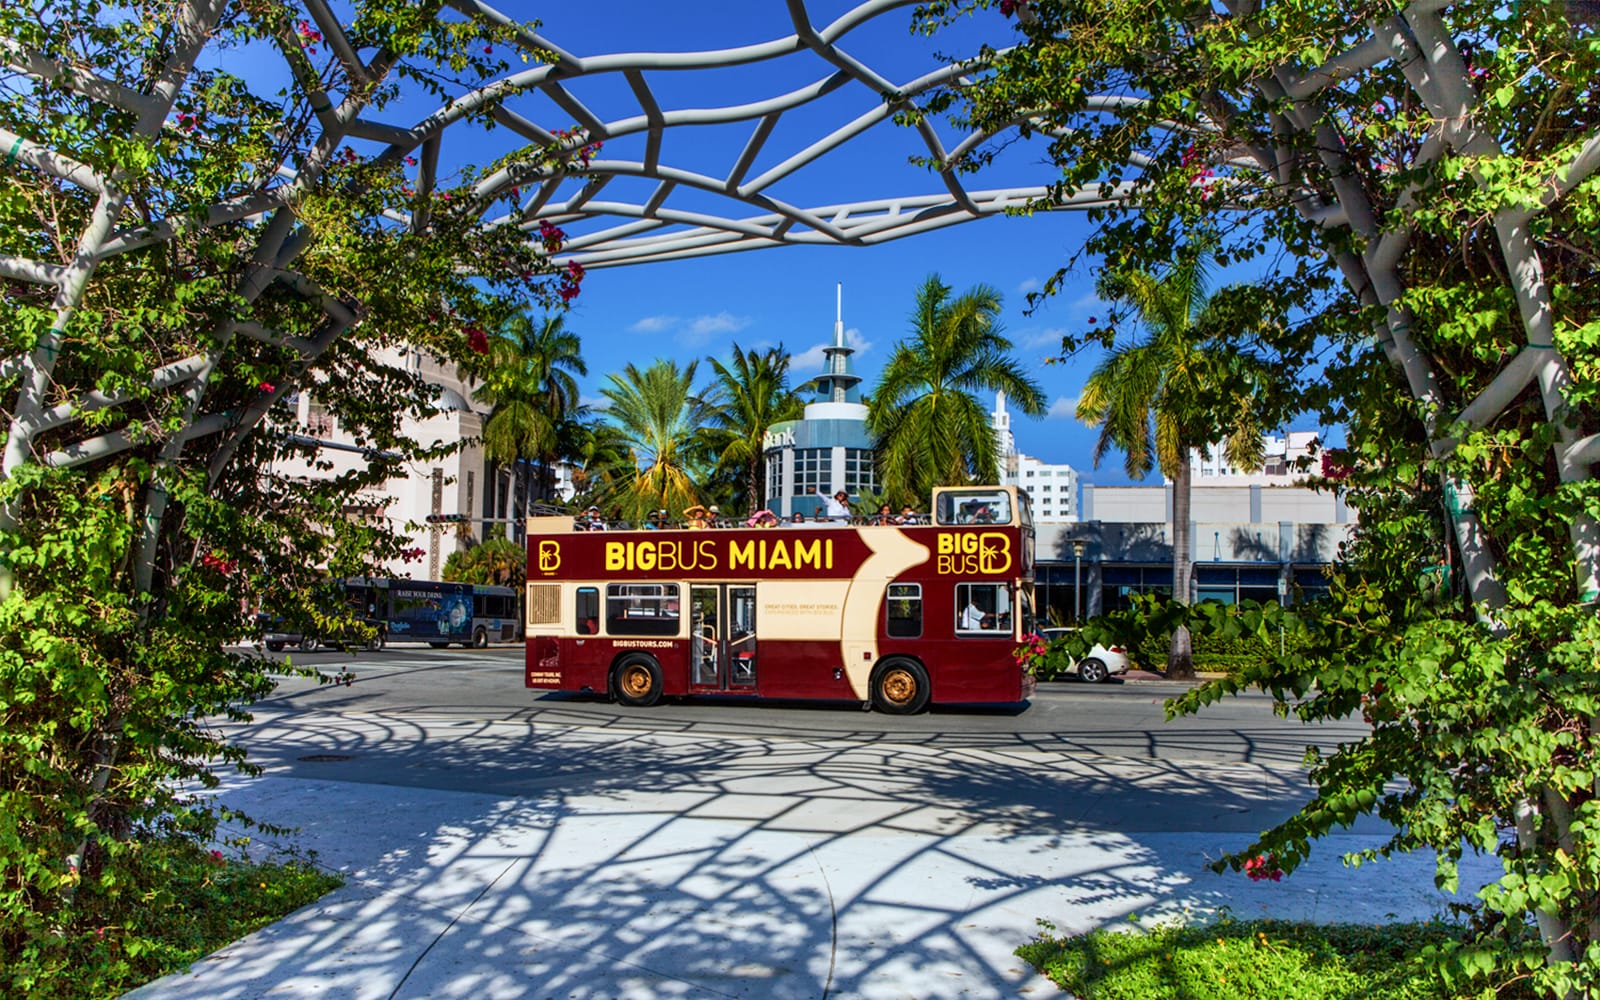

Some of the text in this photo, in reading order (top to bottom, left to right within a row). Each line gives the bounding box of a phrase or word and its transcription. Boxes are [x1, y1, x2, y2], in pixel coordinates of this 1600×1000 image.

[937, 532, 978, 554] BIG
[729, 539, 833, 570] MIAMI
[937, 555, 979, 575] BUS
[612, 640, 673, 648] BIGBUSTOURS.COM
